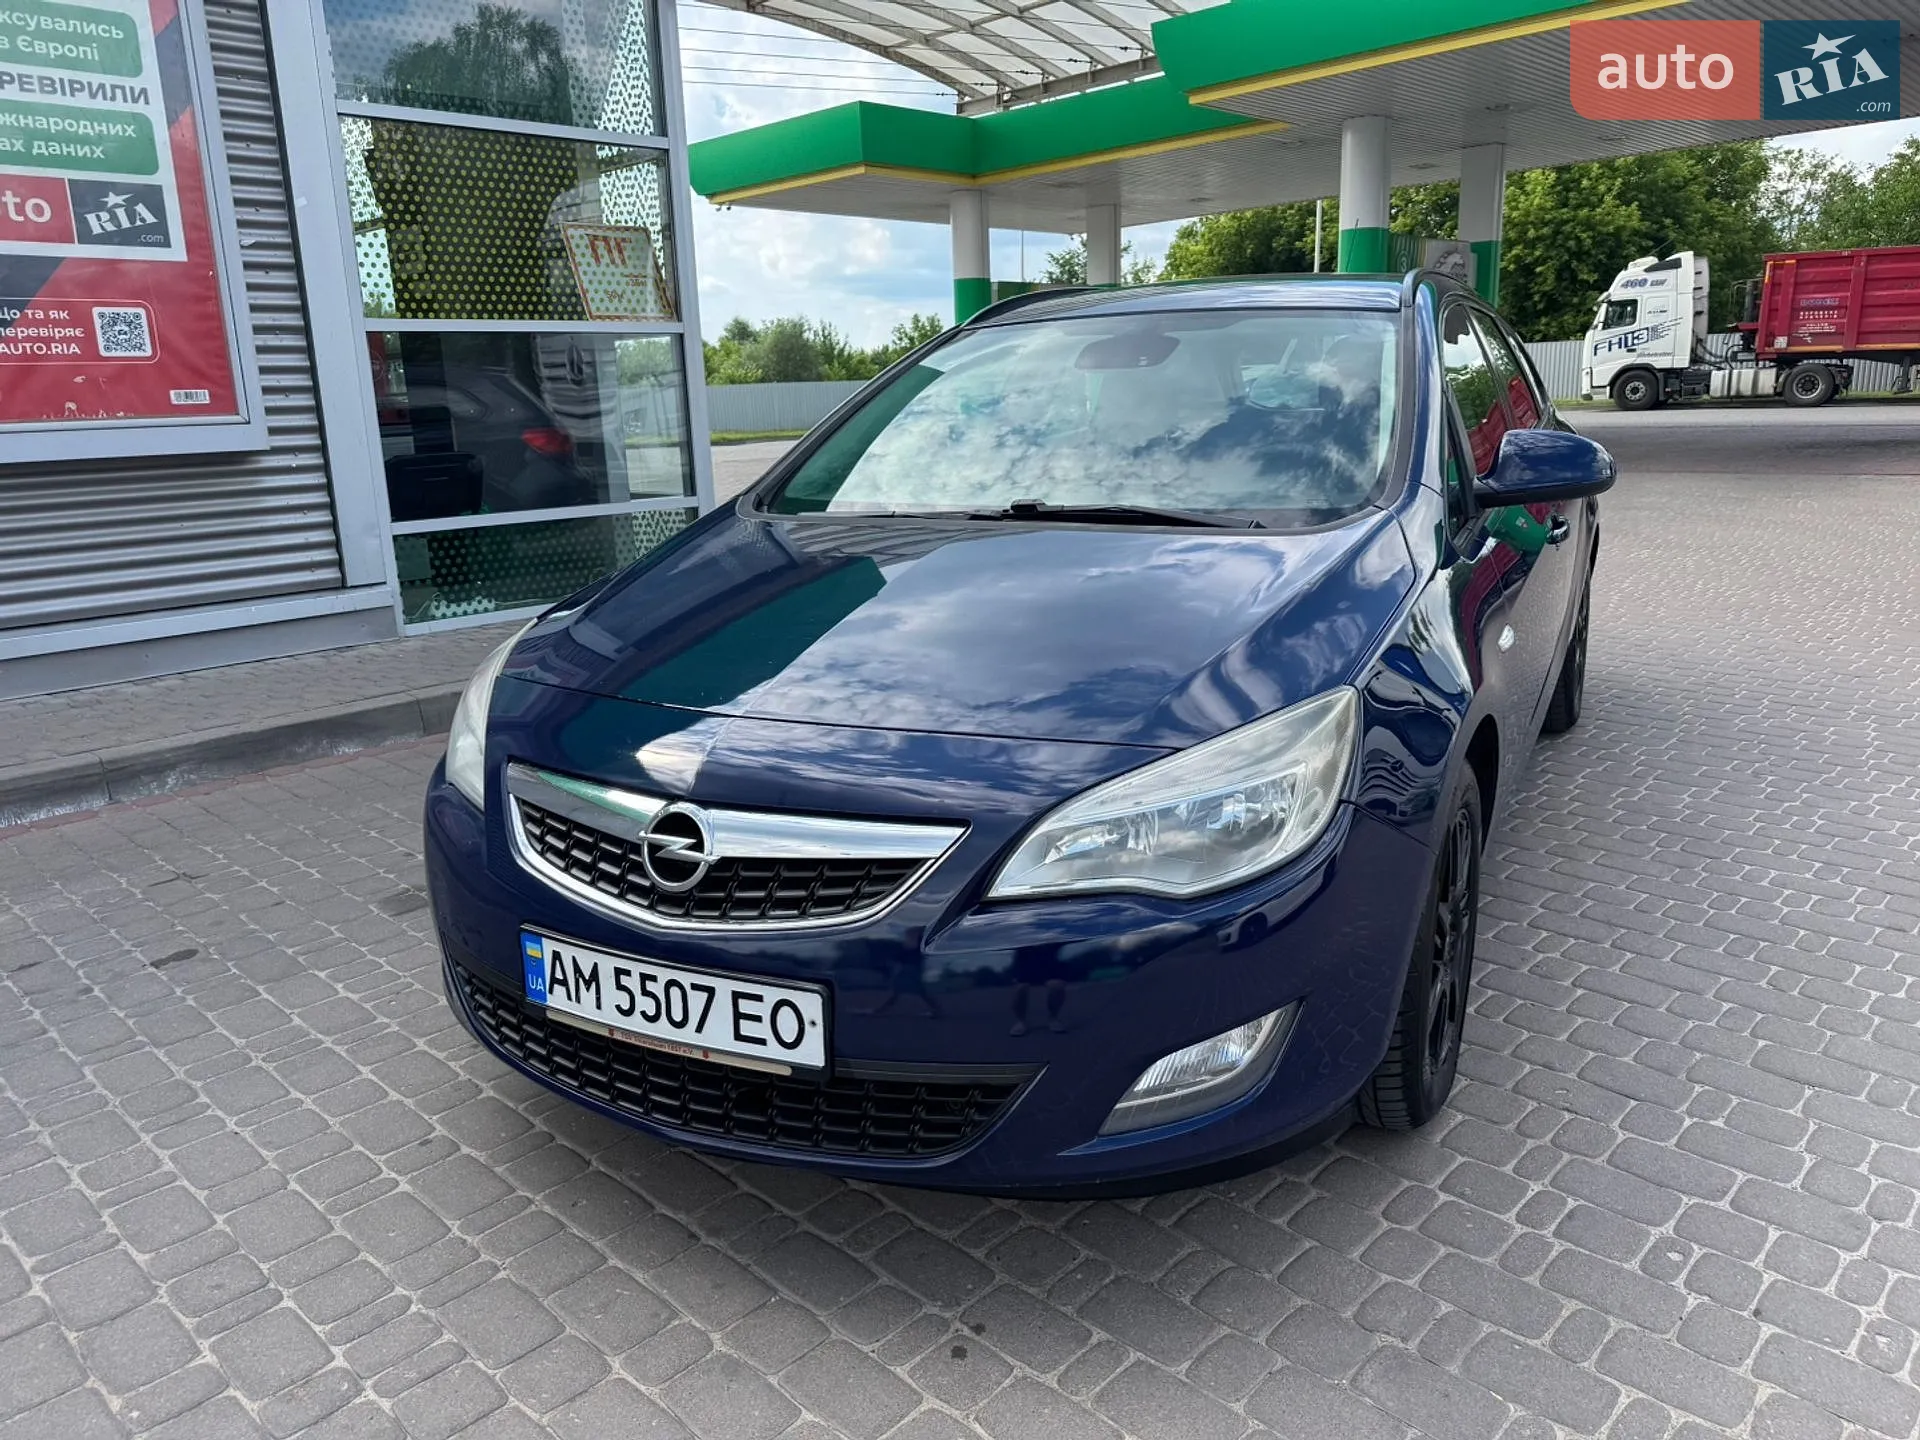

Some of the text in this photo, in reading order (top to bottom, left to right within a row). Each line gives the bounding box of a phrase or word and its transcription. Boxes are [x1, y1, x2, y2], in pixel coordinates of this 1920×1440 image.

[16, 35, 99, 61] Європі
[0, 71, 150, 105] РЕВІРИЛИ
[32, 140, 105, 159] даних
[84, 202, 160, 236] RIA
[137, 233, 165, 244] .com
[24, 309, 44, 319] та
[49, 310, 70, 320] як
[0, 343, 81, 355] AUTO.RIA
[528, 974, 545, 992] UA
[548, 950, 806, 1050] AM 5507 EO
